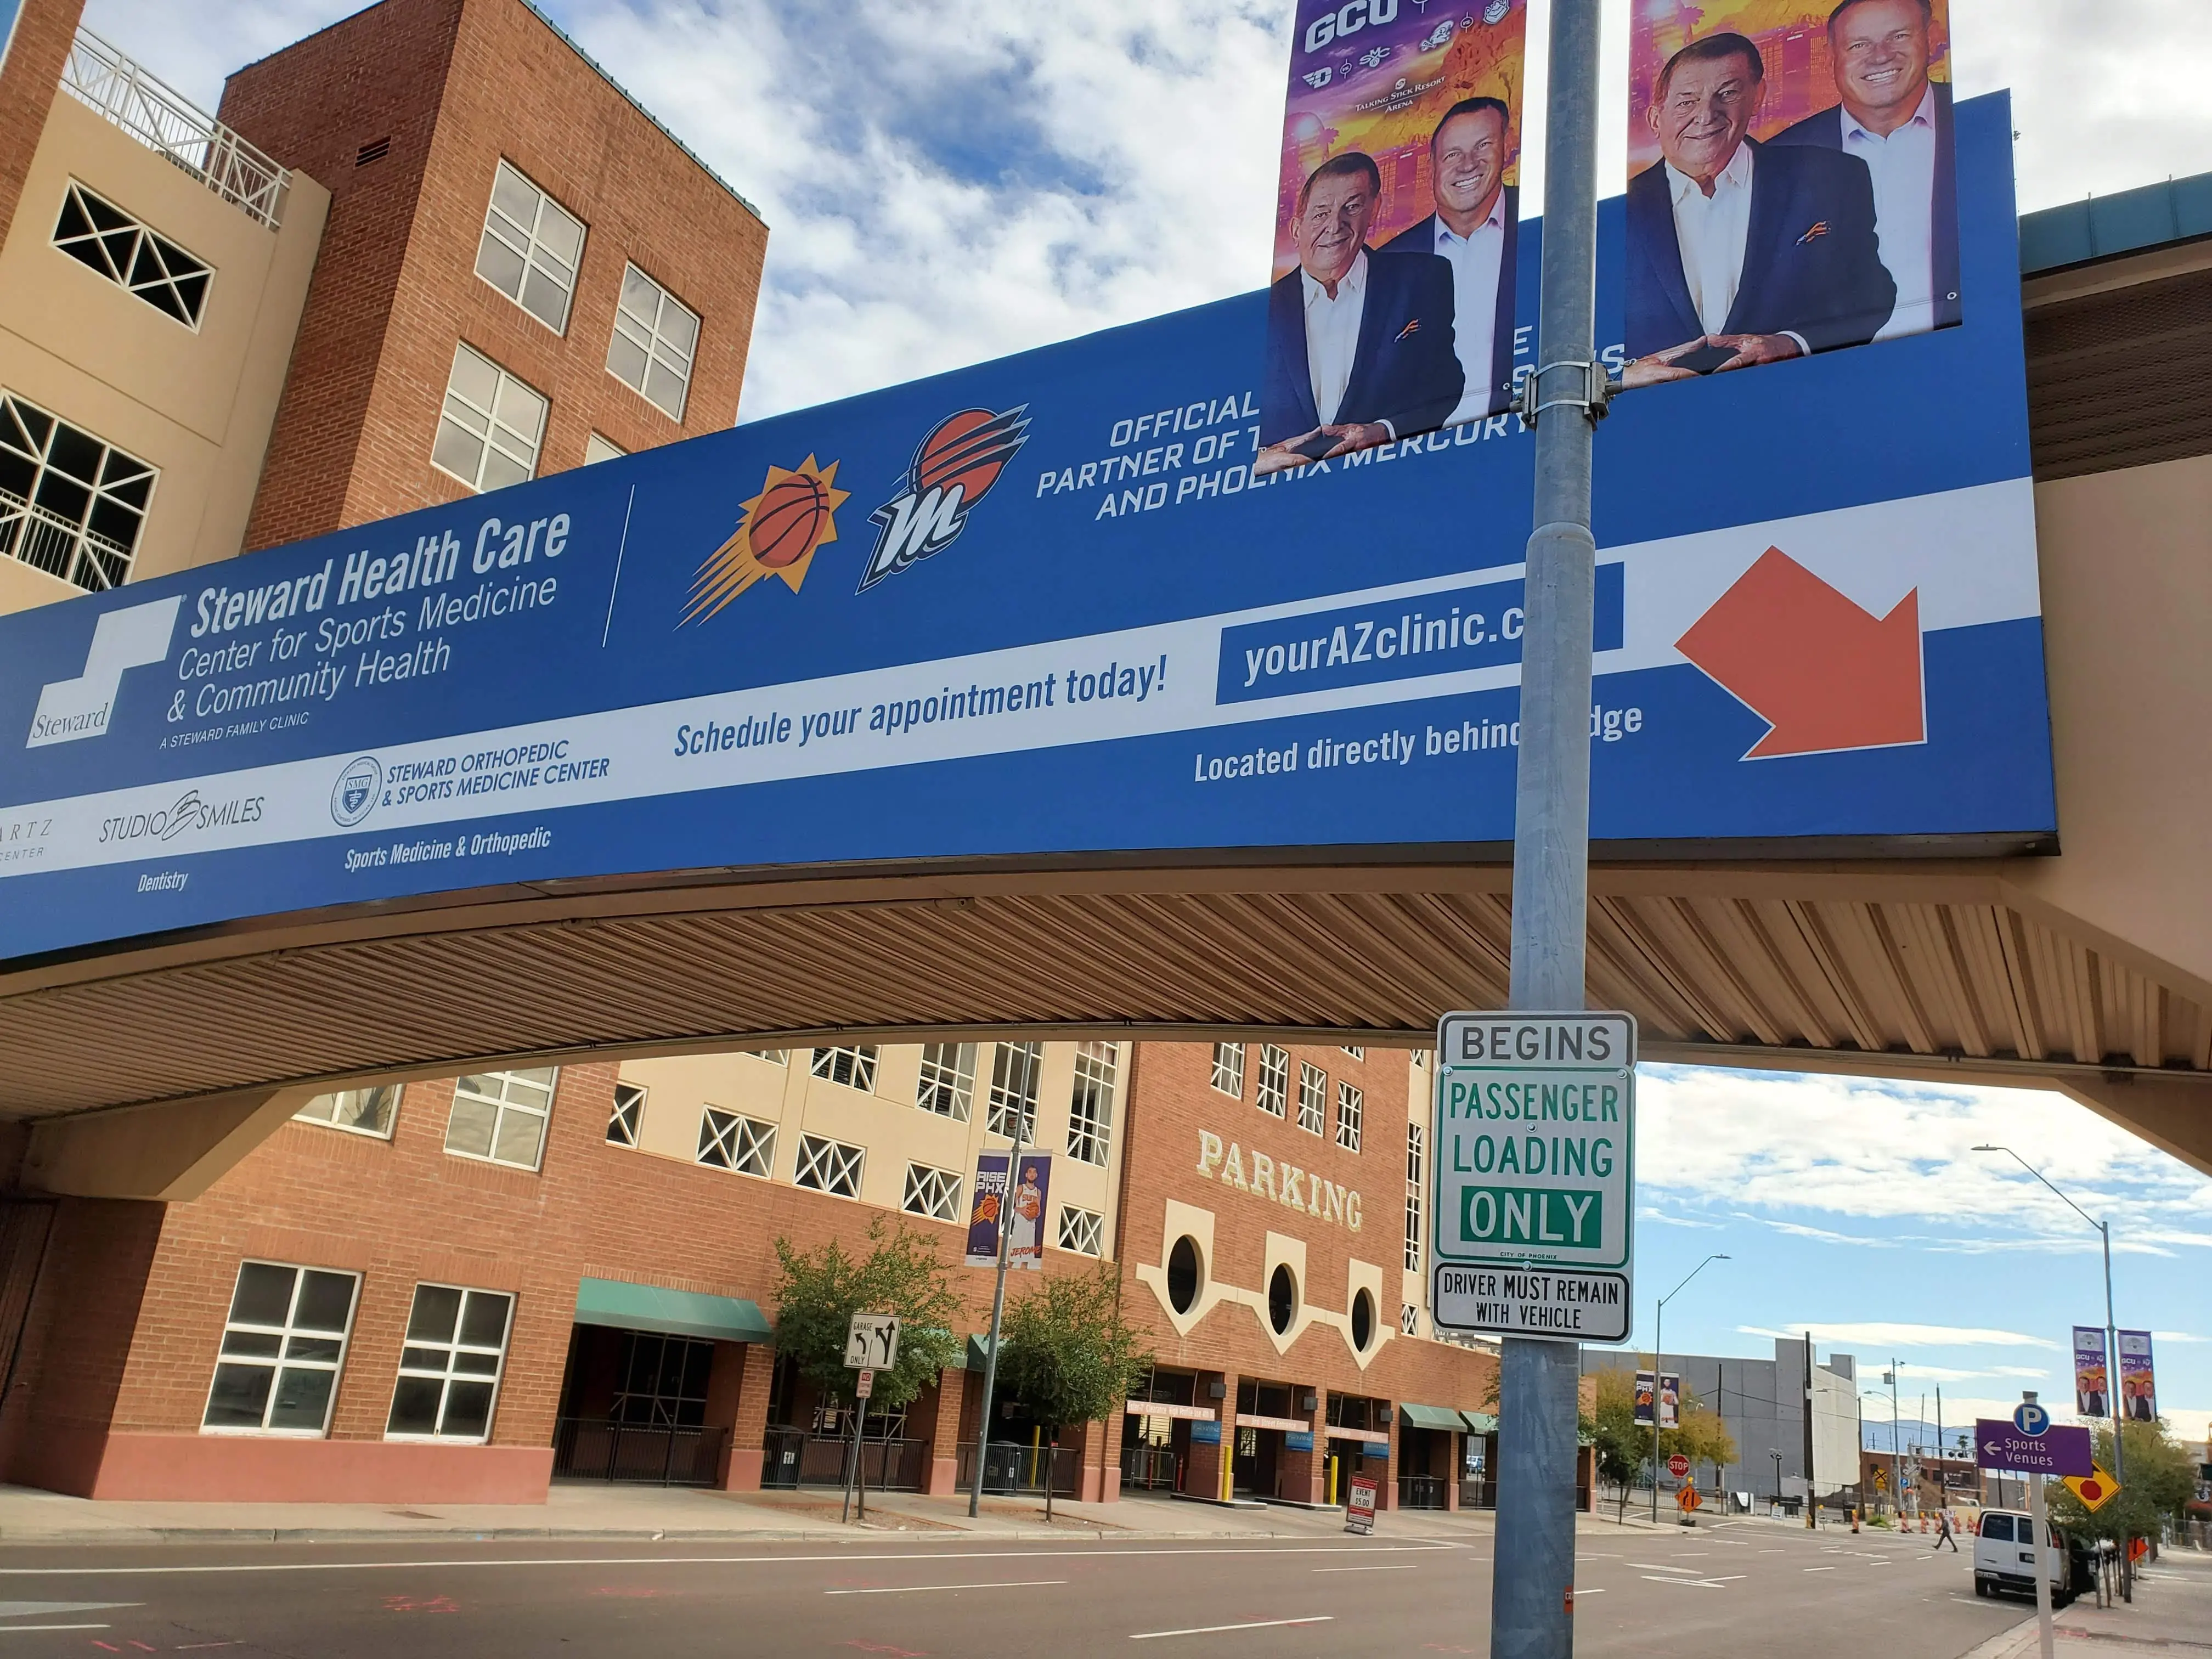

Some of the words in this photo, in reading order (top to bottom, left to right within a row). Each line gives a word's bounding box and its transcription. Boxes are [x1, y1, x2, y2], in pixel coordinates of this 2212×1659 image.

[1305, 0, 1398, 53] GCU
[1355, 97, 1389, 111] TALKING
[1391, 88, 1413, 100] STICK
[1415, 76, 1446, 92] RESORT
[1385, 100, 1413, 114] ARENA
[1110, 391, 1260, 447] OFFICIAL
[1036, 443, 1183, 498] PARTNER
[1193, 430, 1239, 464] OF
[1095, 482, 1167, 521] AND
[191, 558, 333, 638] Steward
[337, 531, 460, 605] Health
[472, 514, 571, 574] Care
[179, 640, 261, 680] Center
[269, 628, 307, 662] for
[315, 609, 406, 657] Sports
[417, 577, 557, 632] Medicine
[1244, 607, 1524, 687] yourAZclinic.c
[167, 689, 184, 723] &
[195, 663, 346, 717] Community
[356, 637, 450, 687] Health
[33, 702, 108, 738] Steward
[674, 712, 791, 756] Schedule
[799, 707, 861, 747] your
[870, 674, 1056, 736] appointment
[1066, 654, 1167, 705] today!
[160, 737, 166, 749] A
[171, 728, 222, 747] STEWARD
[225, 719, 267, 737] FAMILY
[269, 712, 309, 730] CLINIC
[387, 758, 456, 784] STEWARD
[461, 740, 569, 772] ORTHOPEDIC
[1195, 742, 1298, 782] Located
[1308, 730, 1416, 765] directly
[347, 778, 369, 789] SMG
[382, 790, 392, 806] &
[397, 780, 453, 805] SPORTS
[456, 768, 540, 796] MEDICINE
[544, 758, 610, 784] CENTER
[345, 848, 387, 872] Sports
[390, 838, 450, 865] Medicine
[455, 837, 466, 856] &
[470, 826, 551, 857] Orthopedic
[137, 871, 188, 893] Dentistry
[1462, 1026, 1610, 1060] BEGINS
[1450, 1082, 1618, 1122] PASSENGER
[1454, 1135, 1612, 1178] LOADING
[975, 1182, 1005, 1194] PHX
[977, 1171, 1007, 1182] RISE
[1197, 1128, 1363, 1232] PARKING
[1470, 1191, 1593, 1242] ONLY
[1011, 1245, 1041, 1257] JEROME
[1444, 1273, 1496, 1296] DRIVER
[1504, 1276, 1550, 1301] MUST
[1558, 1280, 1618, 1305] REMAIN
[853, 1322, 873, 1331] GARAGE
[1476, 1302, 1509, 1324] WITH
[1520, 1305, 1581, 1329] VEHICLE
[850, 1356, 865, 1364] ONLY
[2022, 1407, 2042, 1431] P
[2005, 1438, 2046, 1452] Sports
[2006, 1452, 2053, 1466] Venues
[1669, 1461, 1688, 1470] STOP
[1356, 1488, 1371, 1497] EVENT
